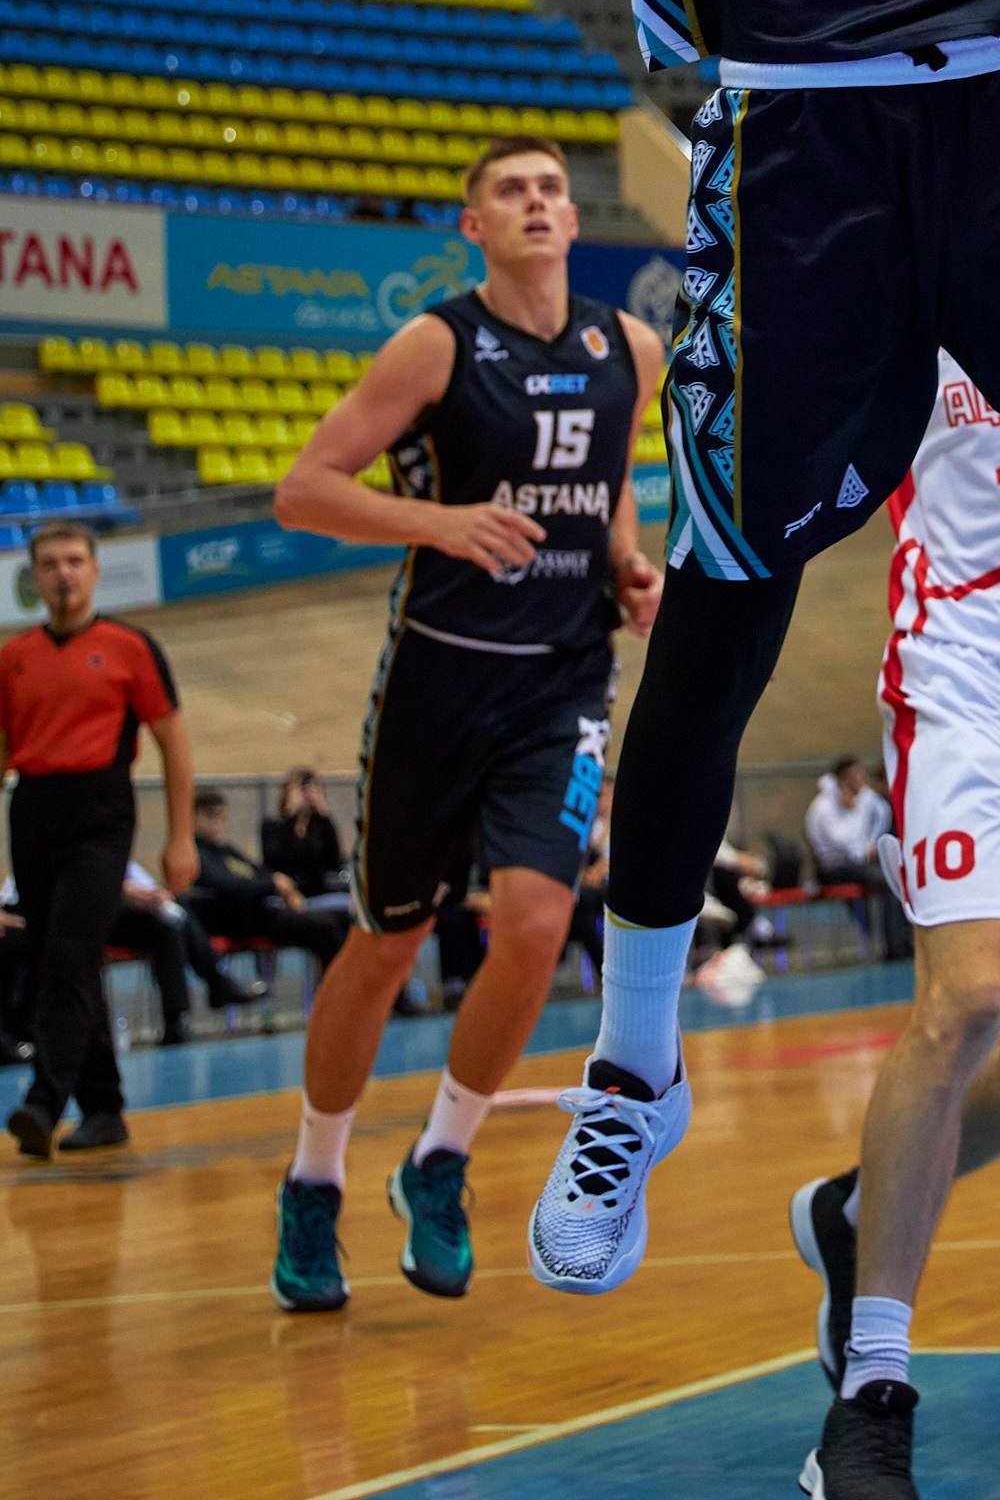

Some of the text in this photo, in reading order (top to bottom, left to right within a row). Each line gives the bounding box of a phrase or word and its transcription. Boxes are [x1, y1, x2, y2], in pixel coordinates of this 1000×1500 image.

[531, 407, 596, 470] 15
[491, 479, 611, 525] ASTANA
[912, 829, 977, 891] 10
